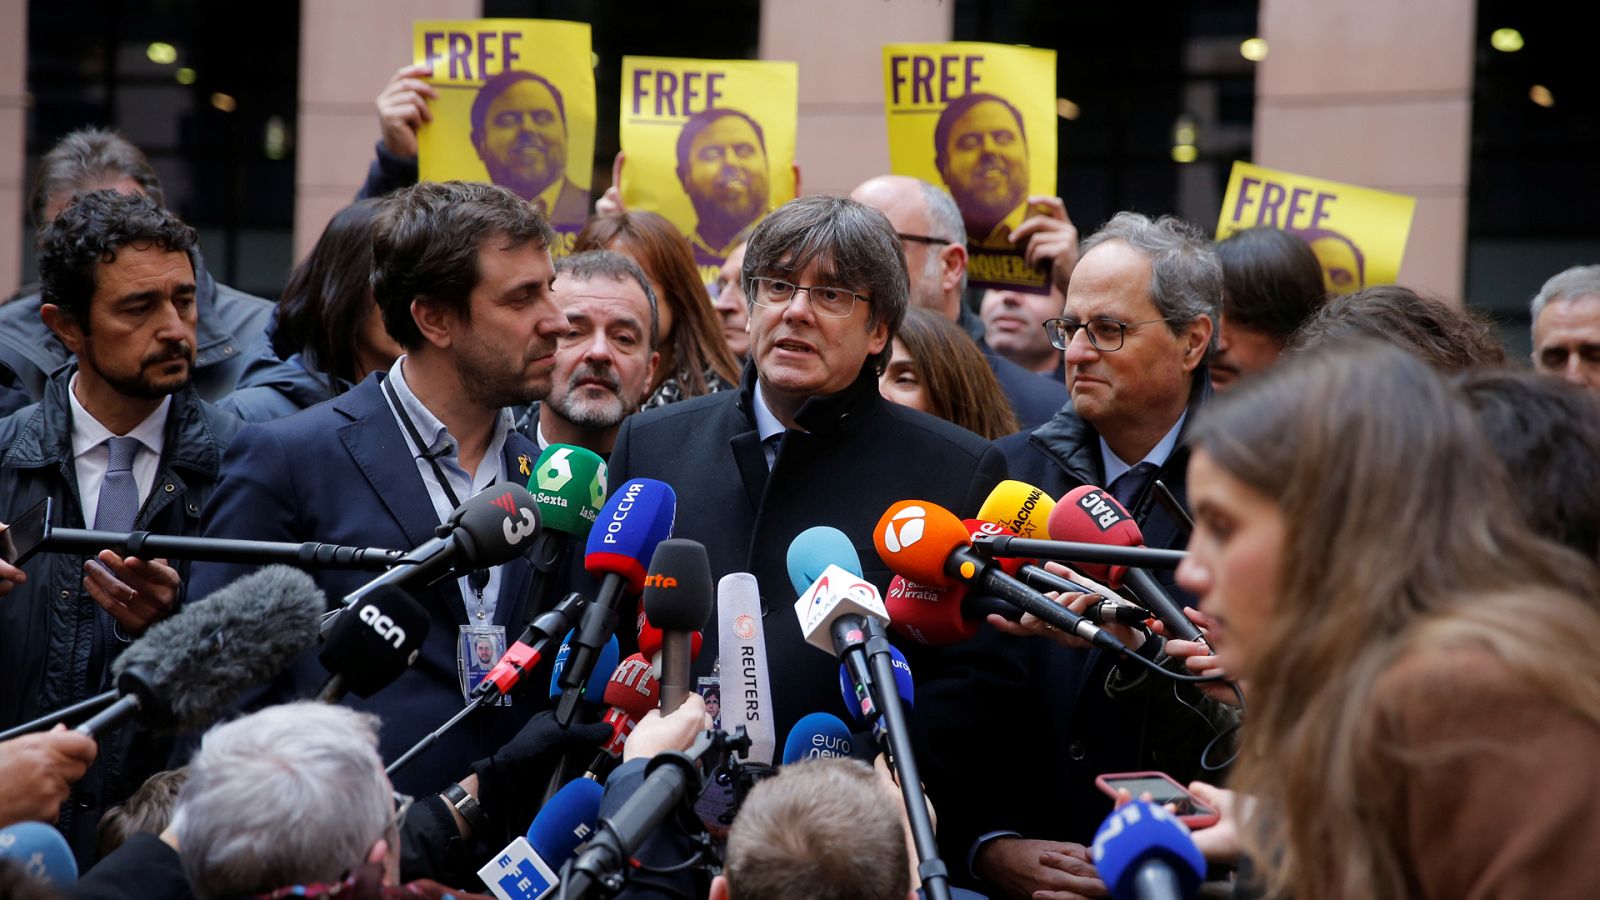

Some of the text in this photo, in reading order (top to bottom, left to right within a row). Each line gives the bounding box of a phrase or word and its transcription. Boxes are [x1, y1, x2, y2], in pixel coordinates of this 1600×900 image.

[424, 31, 522, 80] FREE
[892, 55, 984, 104] FREE
[632, 69, 725, 116] FREE
[1232, 177, 1337, 232] FREE
[503, 507, 536, 545] 3
[604, 483, 644, 544] РОССИЯ
[1081, 493, 1120, 529] RAC
[359, 604, 406, 649] acn
[741, 646, 759, 721] REUTERS
[812, 733, 850, 753] euro
